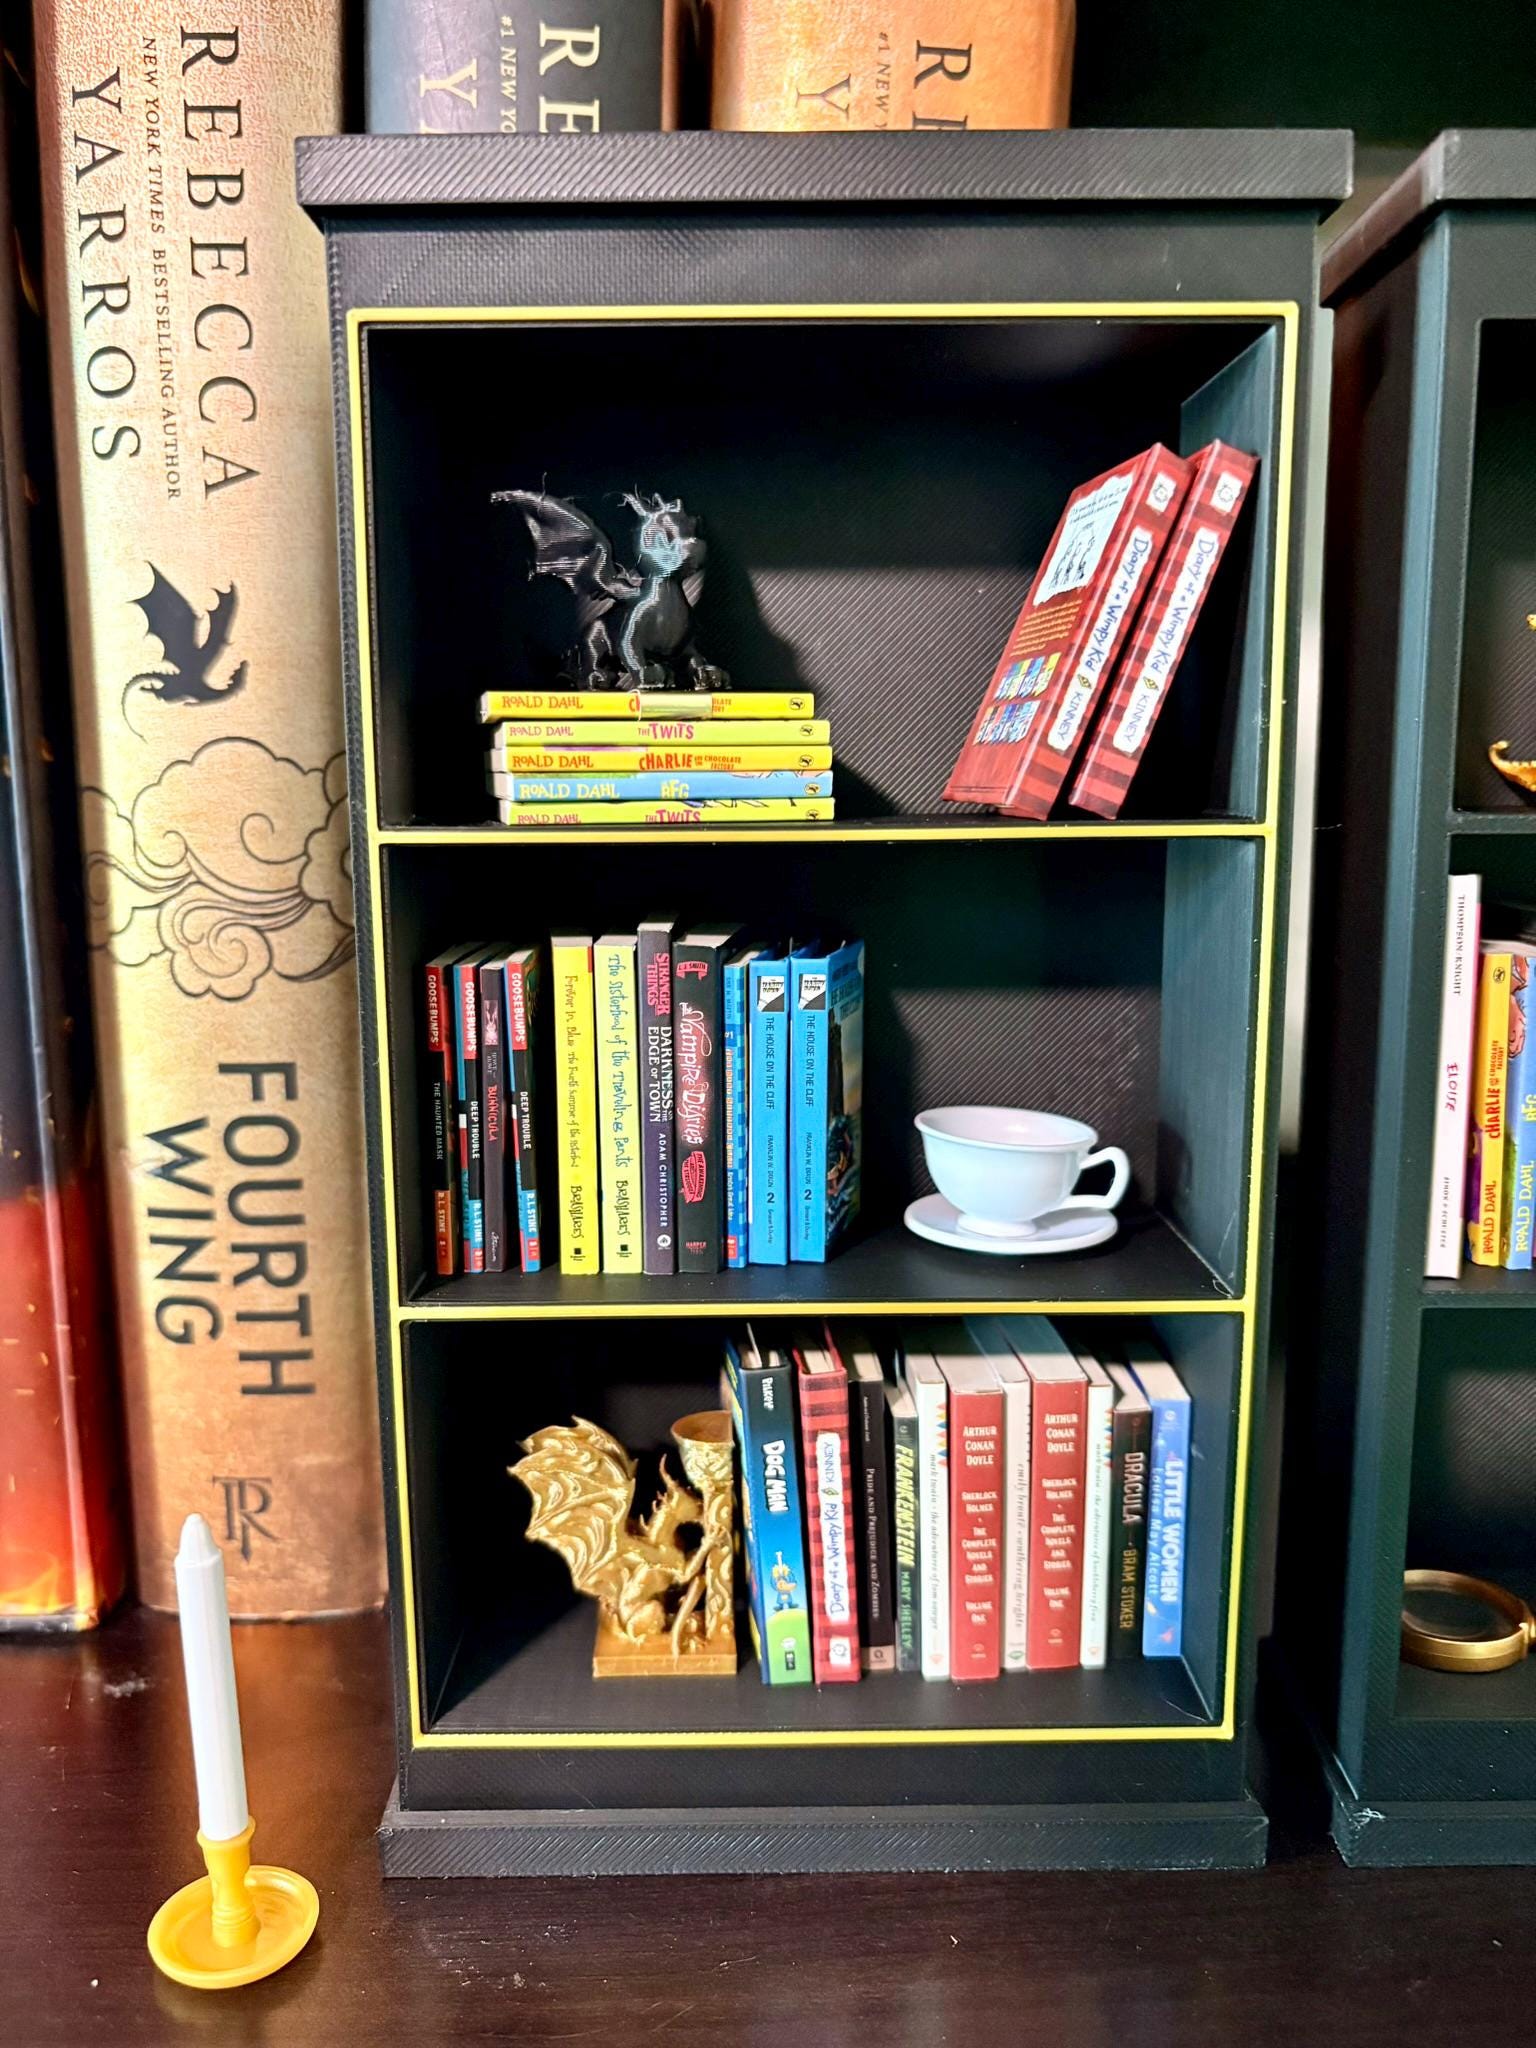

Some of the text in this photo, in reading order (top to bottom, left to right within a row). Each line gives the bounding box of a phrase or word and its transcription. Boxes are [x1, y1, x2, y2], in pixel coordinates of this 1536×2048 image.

[875, 63, 891, 113] NEW
[72, 67, 141, 460] YARROS
[142, 37, 181, 501] NEW YORK TIMES BESTSELLING AUTHOR
[180, 26, 261, 499] REBECCA
[1122, 536, 1149, 580] Diary
[1187, 539, 1215, 580] Diary
[1119, 580, 1128, 594] of
[1184, 582, 1195, 595] of
[1094, 605, 1122, 646] Wimpy
[1158, 607, 1189, 648] Wimpy
[1085, 647, 1105, 672] Kid
[1151, 649, 1172, 673] Kid
[502, 695, 584, 709] ROALD DAHL
[1057, 690, 1083, 741] KINNEY
[1124, 693, 1149, 742] KINNEY
[509, 726, 574, 737] ROALD DAHL
[638, 723, 694, 740] THE TWITS
[512, 755, 594, 768] ROALD DAHL
[639, 752, 694, 771] CHARLIE
[704, 755, 742, 764] CHOCOLATE
[519, 783, 620, 800] ROALD DAHL
[661, 780, 690, 800] BFG
[517, 814, 582, 825] ROALD DAHL
[656, 809, 702, 824] TWITS
[647, 965, 659, 1006] THINGS
[655, 953, 671, 1017] STRANGER
[427, 974, 441, 1046] GOOSEBUMPS
[465, 981, 477, 1053] GOOSEBUMPS
[511, 972, 526, 1044] GOOSEBUMPS
[606, 954, 634, 1168] The Sisterhood of the Traveling Pants
[648, 1026, 660, 1065] EDGE
[766, 1017, 775, 1110] THE HOUSE ON THE CLIFF
[805, 1014, 816, 1107] THE HOUSE ON THE CLIFF
[1489, 1040, 1499, 1077] CHOCOLATE
[1496, 1047, 1505, 1070] FACTORY
[660, 1026, 673, 1110] DARKNESS
[649, 1081, 662, 1123] TOWN
[1444, 1063, 1460, 1112] ELOISE
[433, 1082, 444, 1160] THE HAUNTED MASK
[470, 1101, 481, 1159] DEEP TROUBLE
[487, 1084, 500, 1142] BUNNICULA
[520, 1091, 532, 1150] DEEP TROUBLE
[1485, 1087, 1501, 1139] CHARLIE
[766, 1135, 775, 1162] FRANKLIN
[804, 1132, 813, 1158] FRANKLIN
[658, 1132, 669, 1228] ADAM CHRISTOPHER
[766, 1171, 775, 1188] DIXON
[804, 1167, 812, 1185] DIXON
[767, 1192, 776, 1204] 2
[804, 1189, 813, 1201] 2
[1515, 1160, 1535, 1253] ROALD DAHL
[144, 1116, 223, 1345] WING
[217, 1062, 316, 1395] FOURTH
[438, 1211, 446, 1234] STINE
[474, 1218, 483, 1244] STINE
[527, 1209, 537, 1234] STINE
[1482, 1180, 1497, 1254] ROALD DAHL
[762, 1376, 775, 1411] PILKEY
[963, 1426, 997, 1437] ARTHUR
[1044, 1413, 1079, 1424] ARTHUR
[1046, 1428, 1076, 1439] CONAN
[823, 1441, 835, 1484] KINNEY
[965, 1440, 996, 1451] CONAN
[966, 1454, 994, 1466] DOYLE
[1047, 1442, 1075, 1453] DOYLE
[961, 1491, 998, 1501] SHERLOCK
[1042, 1478, 1077, 1488] SHERLOCK
[1045, 1490, 1073, 1499] HOLMES
[1122, 1451, 1145, 1526] DRACULA
[823, 1502, 838, 1521] Kid
[895, 1443, 916, 1569] FRANKENSTEIN
[966, 1503, 994, 1513] HOLMES
[828, 1522, 842, 1560] Wimpy
[866, 1468, 881, 1620] PRIDE AND PREJUDICE AND ZOMBIES
[961, 1538, 997, 1548] COMPLETE
[1040, 1525, 1076, 1535] COMPLETE
[1148, 1467, 1165, 1597] Louisa May Alcott
[1160, 1459, 1185, 1604] LITTLE WOMEN
[829, 1569, 839, 1579] of
[972, 1563, 988, 1572] AND
[829, 1580, 845, 1615] Diary
[1119, 1548, 1137, 1630] BRAM STOKER
[901, 1571, 913, 1651] MARY SHELLEY
